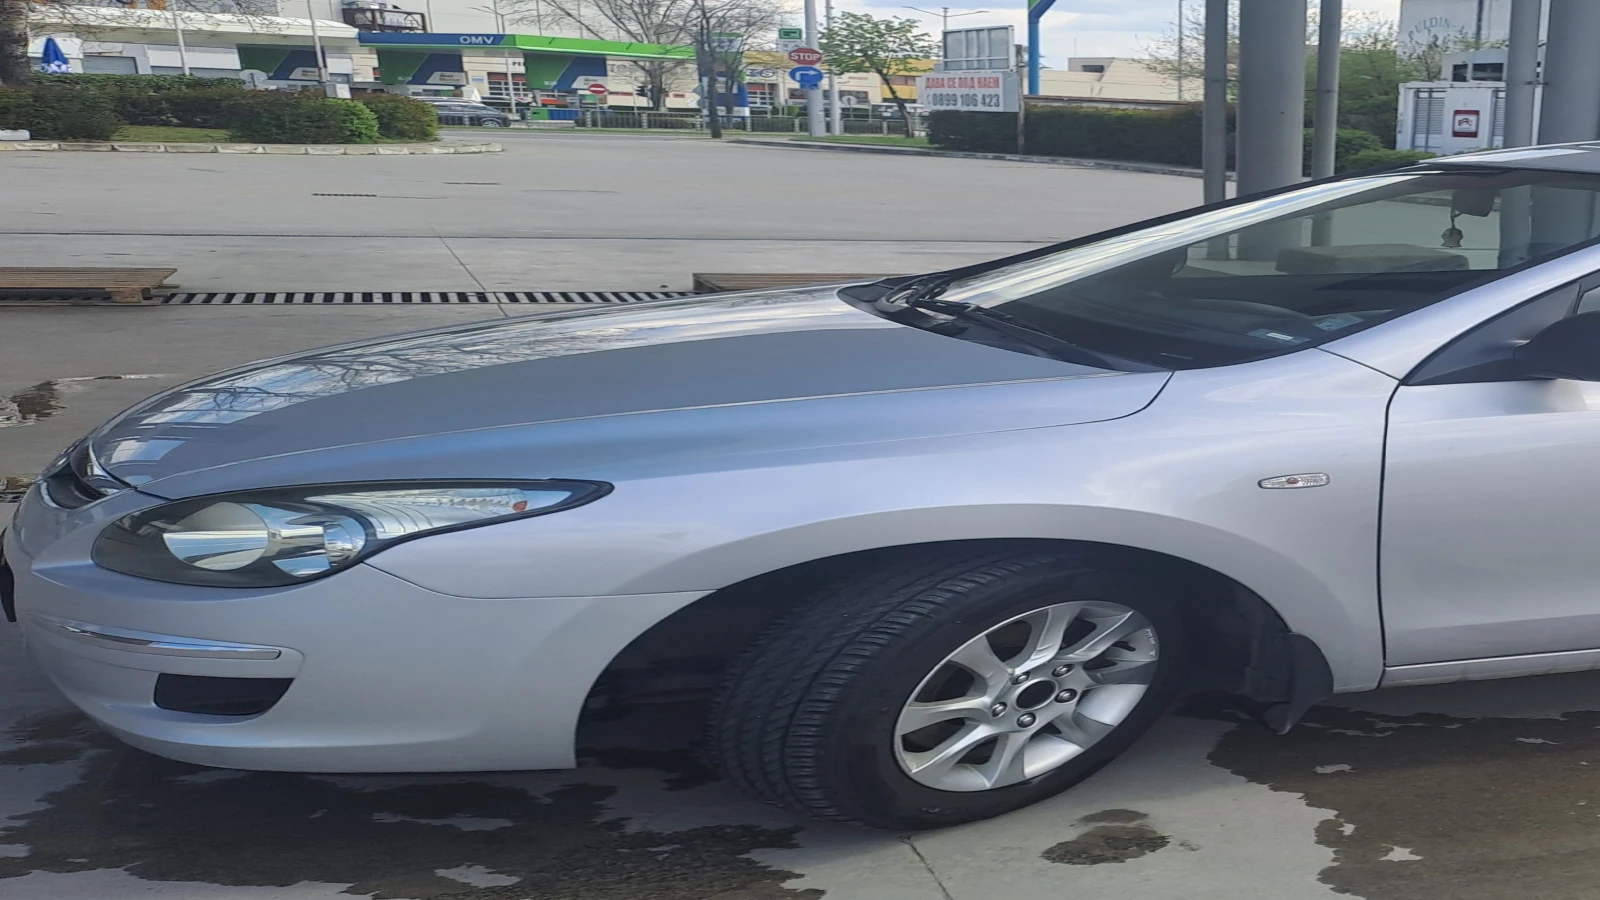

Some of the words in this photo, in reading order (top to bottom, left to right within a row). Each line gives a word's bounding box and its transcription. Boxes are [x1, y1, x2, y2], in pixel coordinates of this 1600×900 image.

[459, 35, 495, 44] OMV
[790, 52, 820, 61] STOP
[932, 92, 958, 106] 0899
[960, 93, 978, 107] 106
[980, 93, 1000, 107] 423
